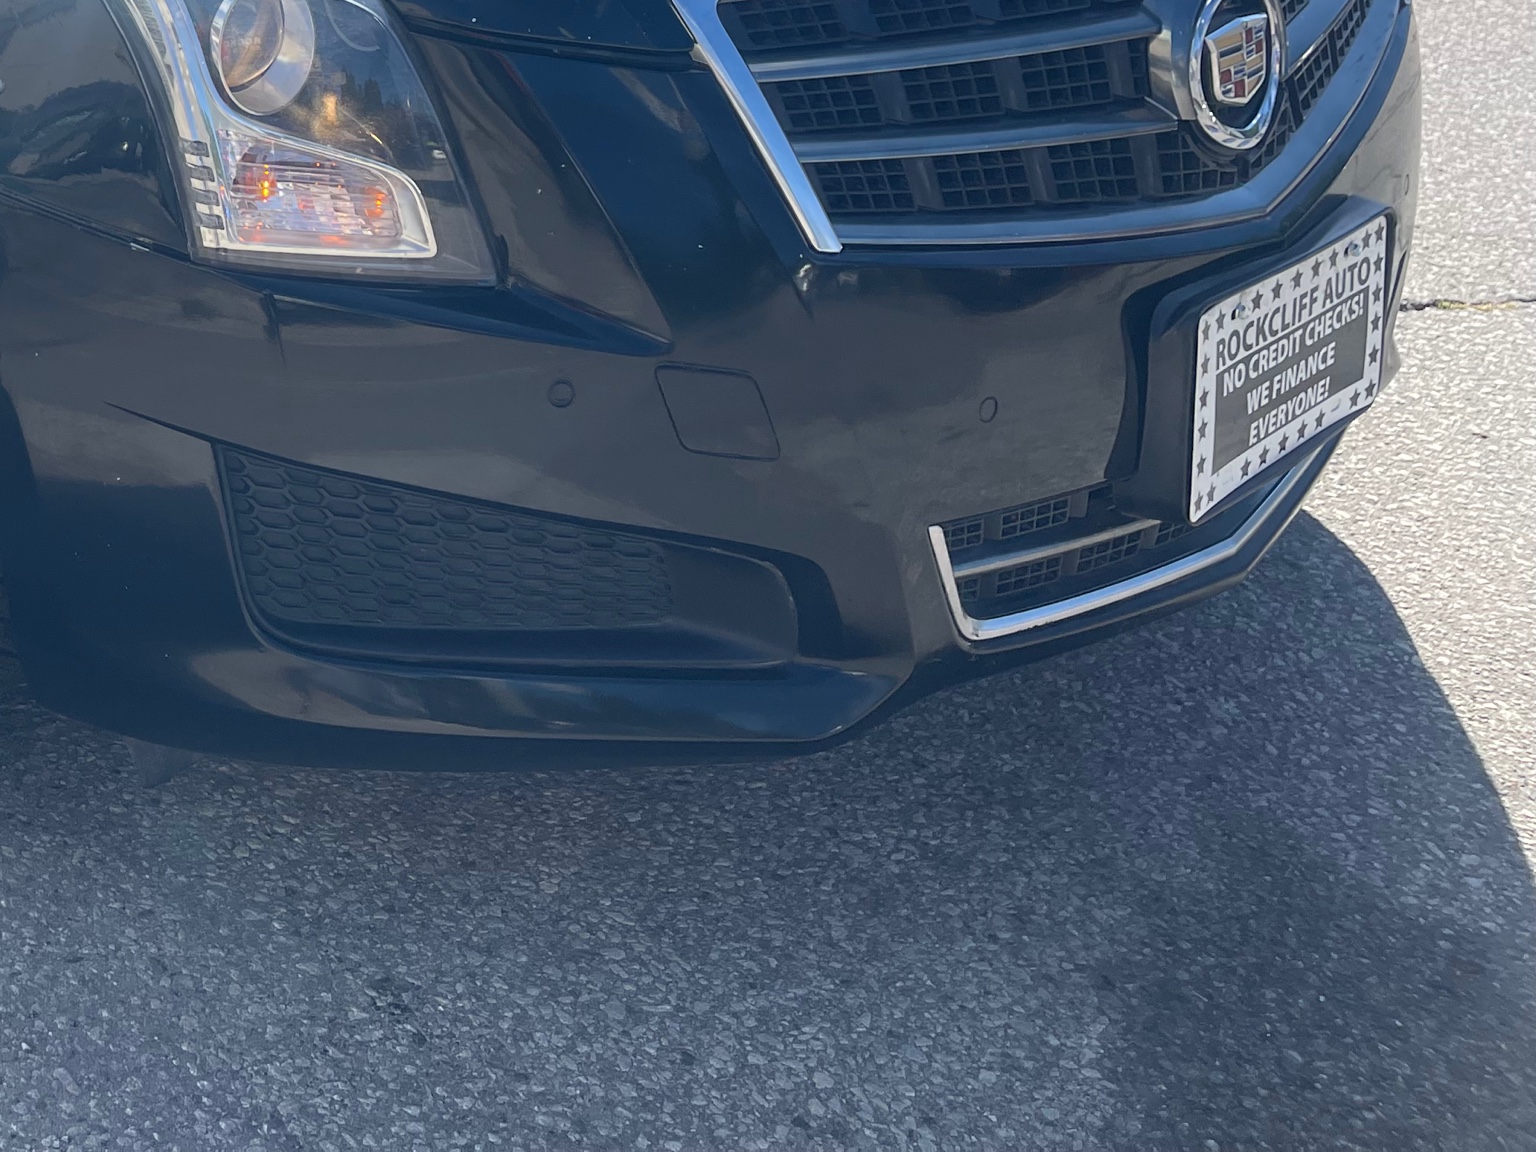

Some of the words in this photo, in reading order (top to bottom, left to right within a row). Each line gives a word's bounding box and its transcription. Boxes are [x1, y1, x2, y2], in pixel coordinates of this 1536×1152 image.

[1216, 286, 1319, 371] ROCKCLIFF
[1323, 256, 1371, 309] AUTO
[1223, 365, 1246, 397] NO
[1248, 329, 1303, 379] CREDIT
[1305, 297, 1364, 346] CHECKS!
[1246, 384, 1270, 415] WE
[1272, 341, 1335, 395] FINANCE
[1248, 376, 1330, 446] EVERYONE!
